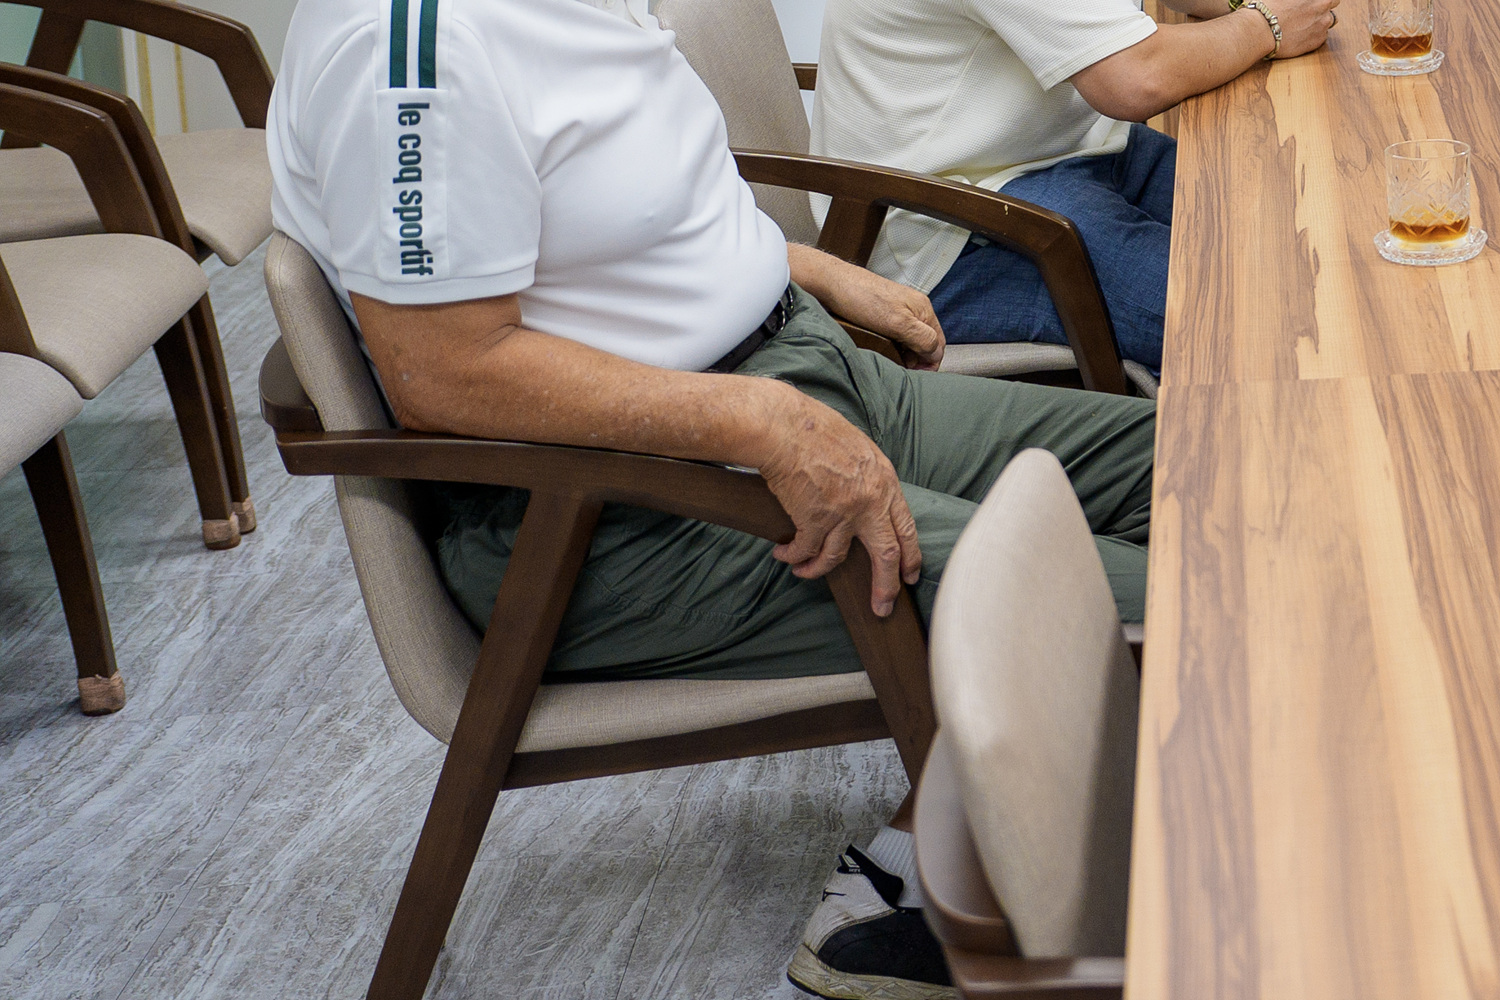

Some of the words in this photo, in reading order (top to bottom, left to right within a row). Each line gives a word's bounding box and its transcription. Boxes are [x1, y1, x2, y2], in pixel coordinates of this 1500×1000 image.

[398, 102, 430, 126] le
[392, 133, 423, 183] coq
[393, 190, 435, 276] sportif
